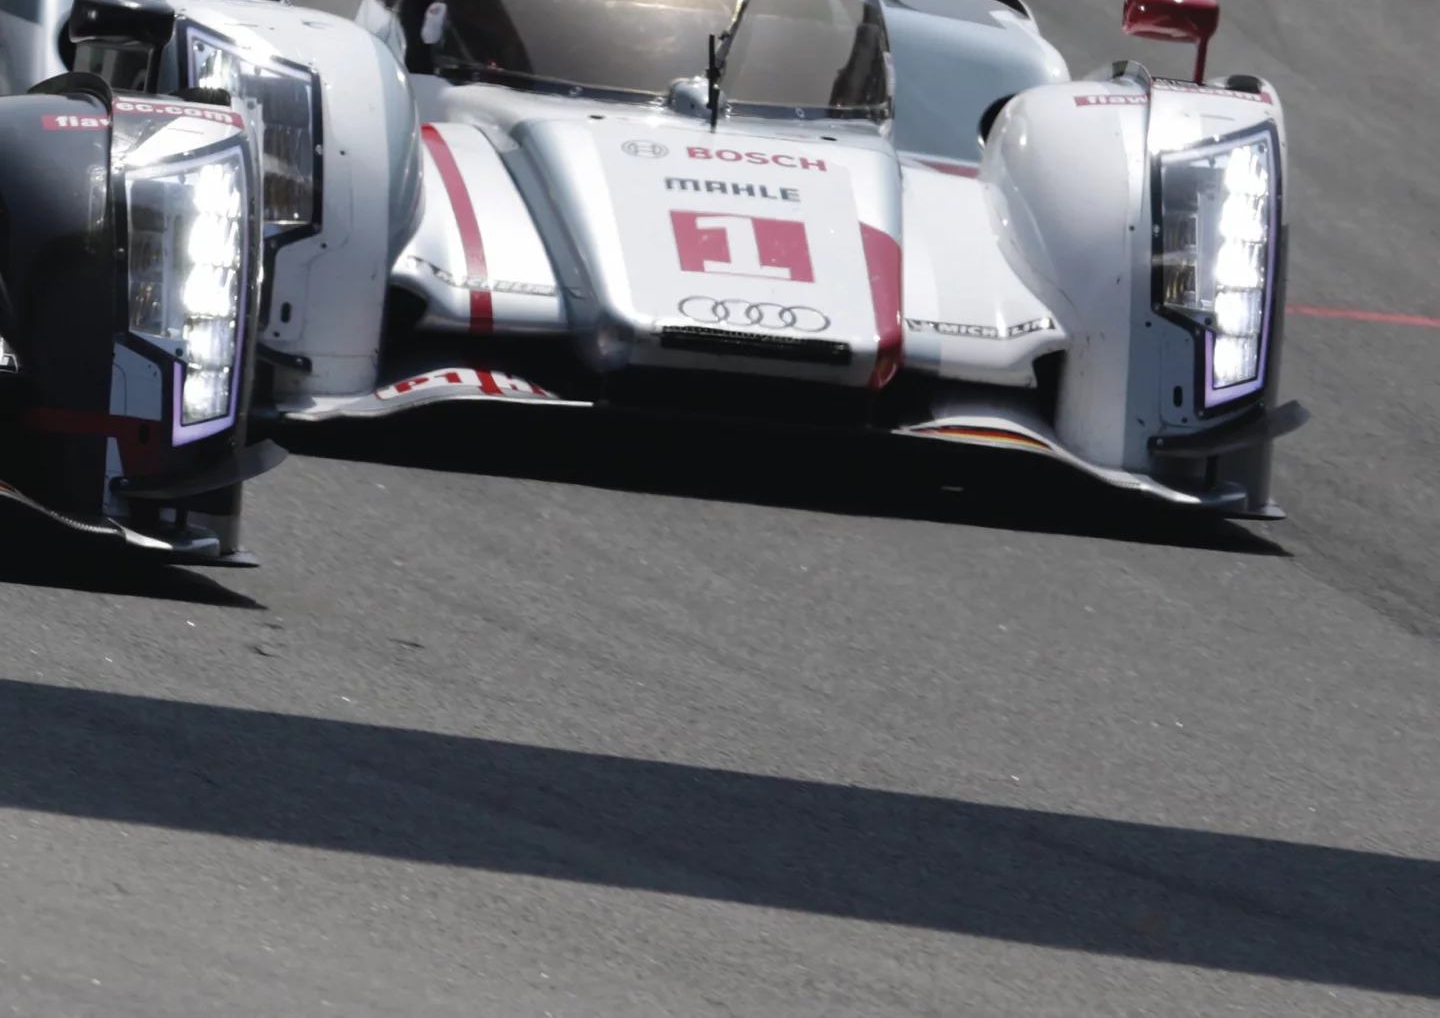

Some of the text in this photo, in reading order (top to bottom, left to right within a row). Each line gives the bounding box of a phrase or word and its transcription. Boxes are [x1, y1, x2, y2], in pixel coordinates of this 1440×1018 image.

[686, 146, 828, 172] BOSCH
[664, 177, 801, 203] MAHLE
[695, 215, 792, 279] 1
[395, 371, 464, 393] P1
